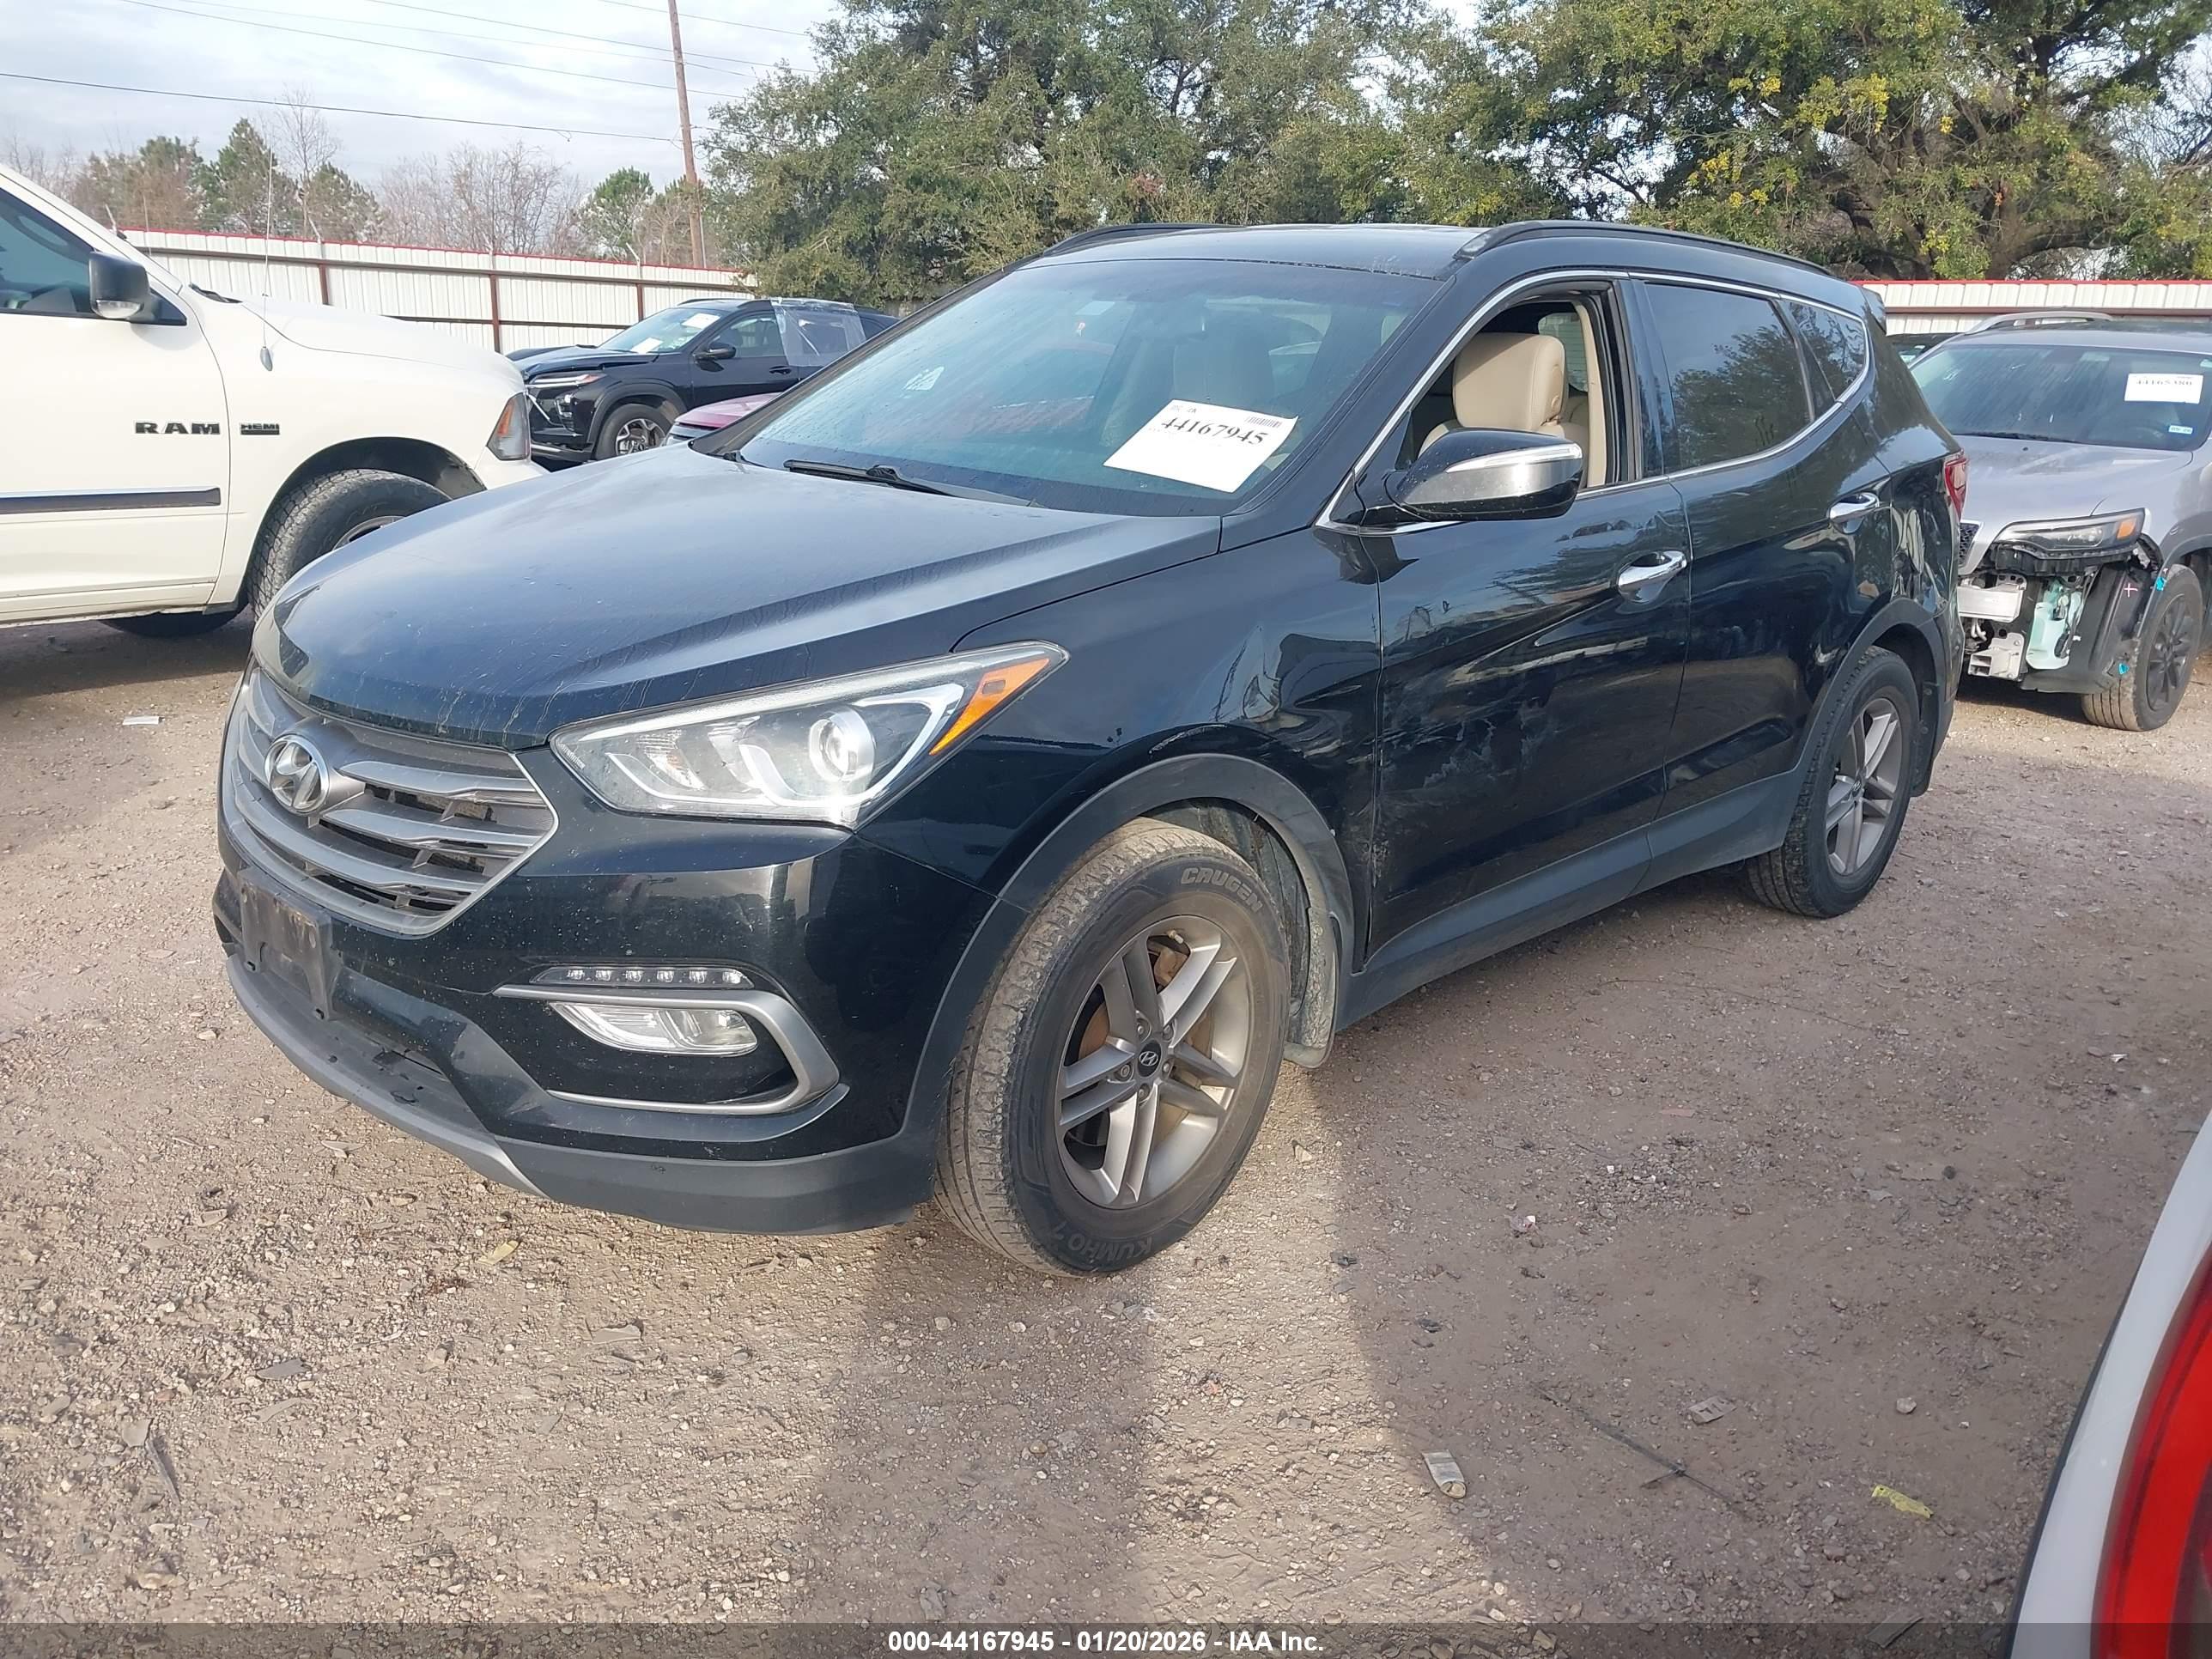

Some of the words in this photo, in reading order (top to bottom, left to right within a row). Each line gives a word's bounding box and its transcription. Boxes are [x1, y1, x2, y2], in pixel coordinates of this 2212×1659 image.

[135, 422, 221, 434] RAM
[240, 422, 280, 431] HEMI
[1161, 416, 1269, 445] 44167945
